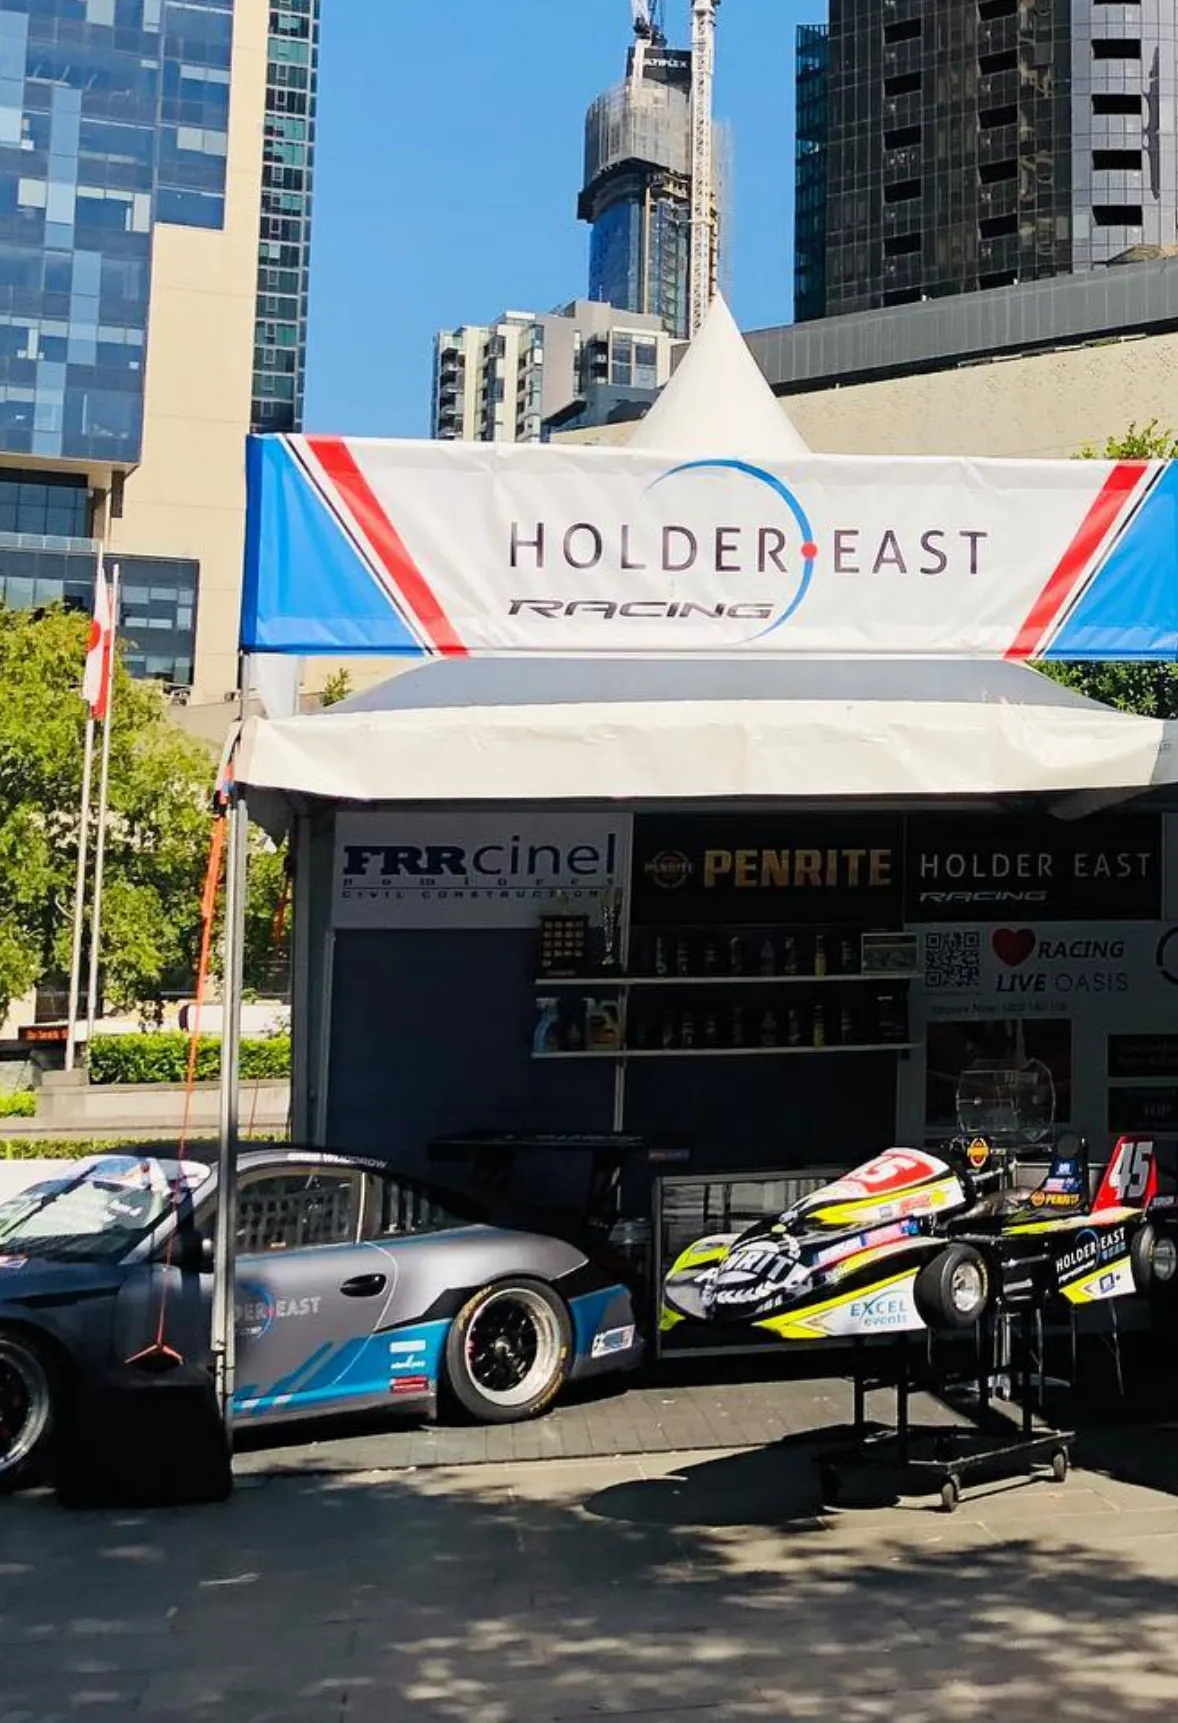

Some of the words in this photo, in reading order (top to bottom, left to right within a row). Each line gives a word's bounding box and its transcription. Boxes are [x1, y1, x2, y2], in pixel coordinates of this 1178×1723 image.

[508, 520, 788, 574] HOLDER
[832, 527, 988, 575] EAST
[507, 598, 776, 620] RACING
[703, 848, 893, 889] PENRITE
[920, 852, 1054, 879] HOLDER
[1073, 852, 1153, 879] EAST
[919, 889, 1049, 903] RACING
[1037, 940, 1125, 959] RACING
[996, 973, 1047, 993] LIVE
[1054, 972, 1129, 992] OASIS
[1108, 1140, 1155, 1201] 45
[1055, 1241, 1097, 1274] HOLDER
[1100, 1226, 1126, 1250] EAST
[275, 1295, 322, 1318] EAST
[850, 1299, 907, 1317] EXCEL
